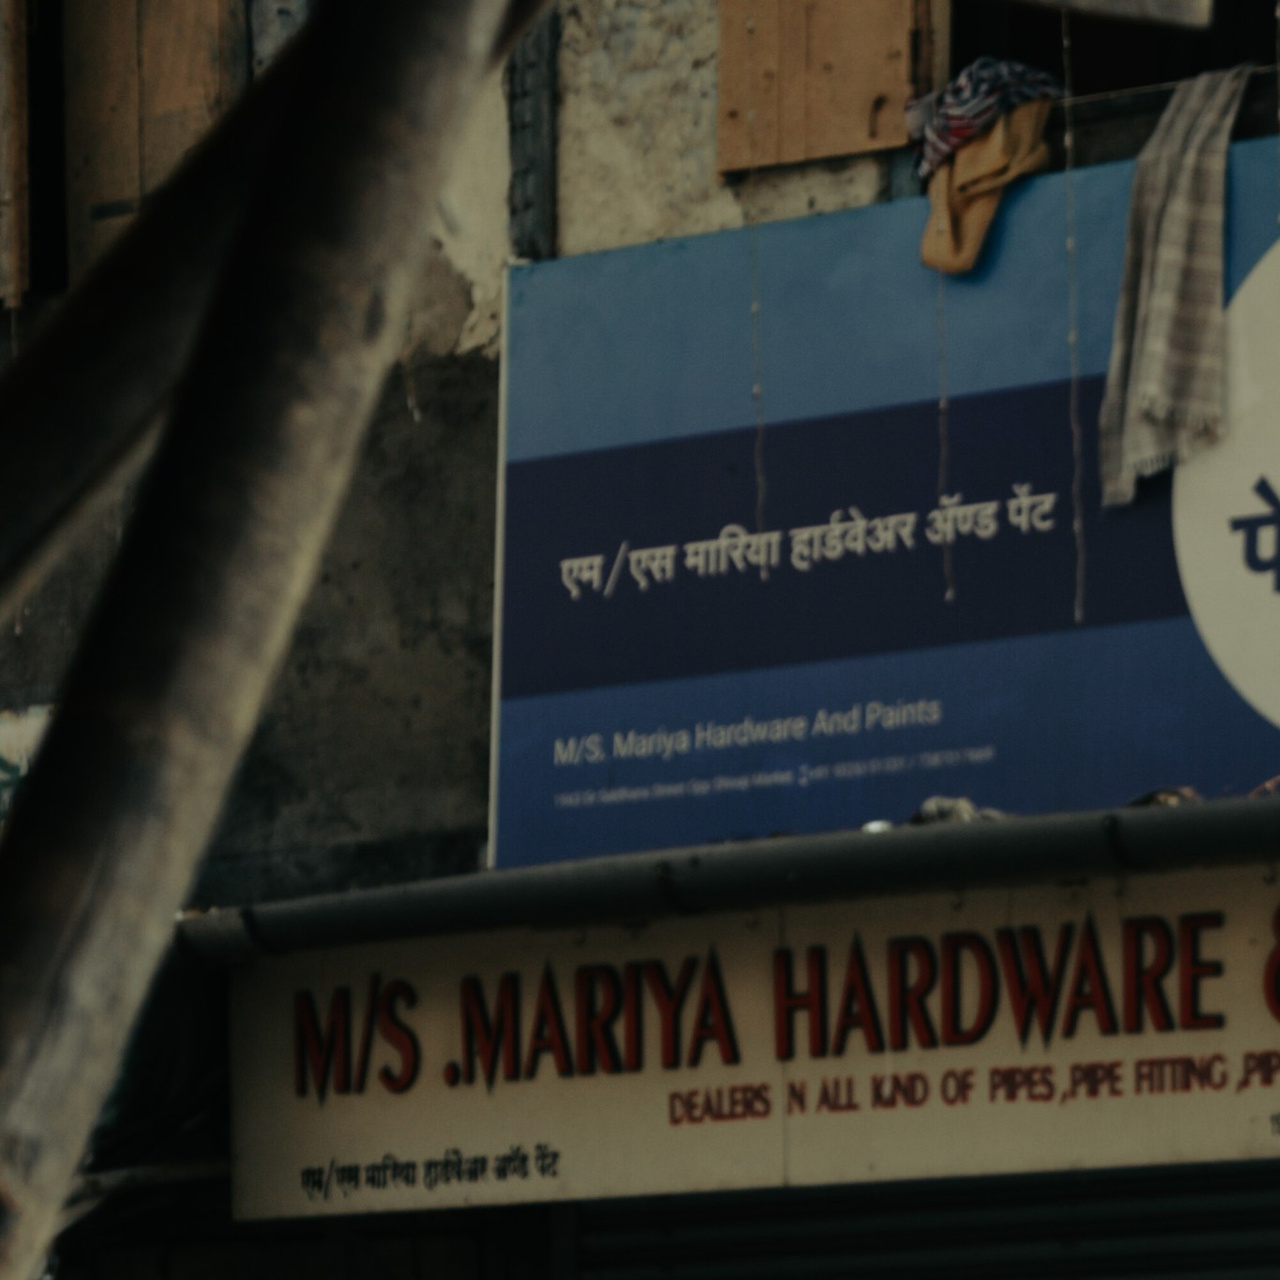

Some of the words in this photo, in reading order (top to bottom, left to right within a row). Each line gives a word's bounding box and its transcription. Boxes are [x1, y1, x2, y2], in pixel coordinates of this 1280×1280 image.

[683, 524, 784, 578] मारिया
[788, 507, 918, 571] हार्डवेअर
[612, 725, 692, 761] Mariya
[695, 714, 808, 750] Hardware
[812, 703, 861, 736] And
[865, 698, 942, 730] Paints
[294, 972, 422, 1107] M/S
[772, 911, 1226, 1062] HARDWARE
[668, 1083, 771, 1126] DEALERS
[816, 1076, 860, 1113] ALL
[941, 1069, 976, 1106] OF
